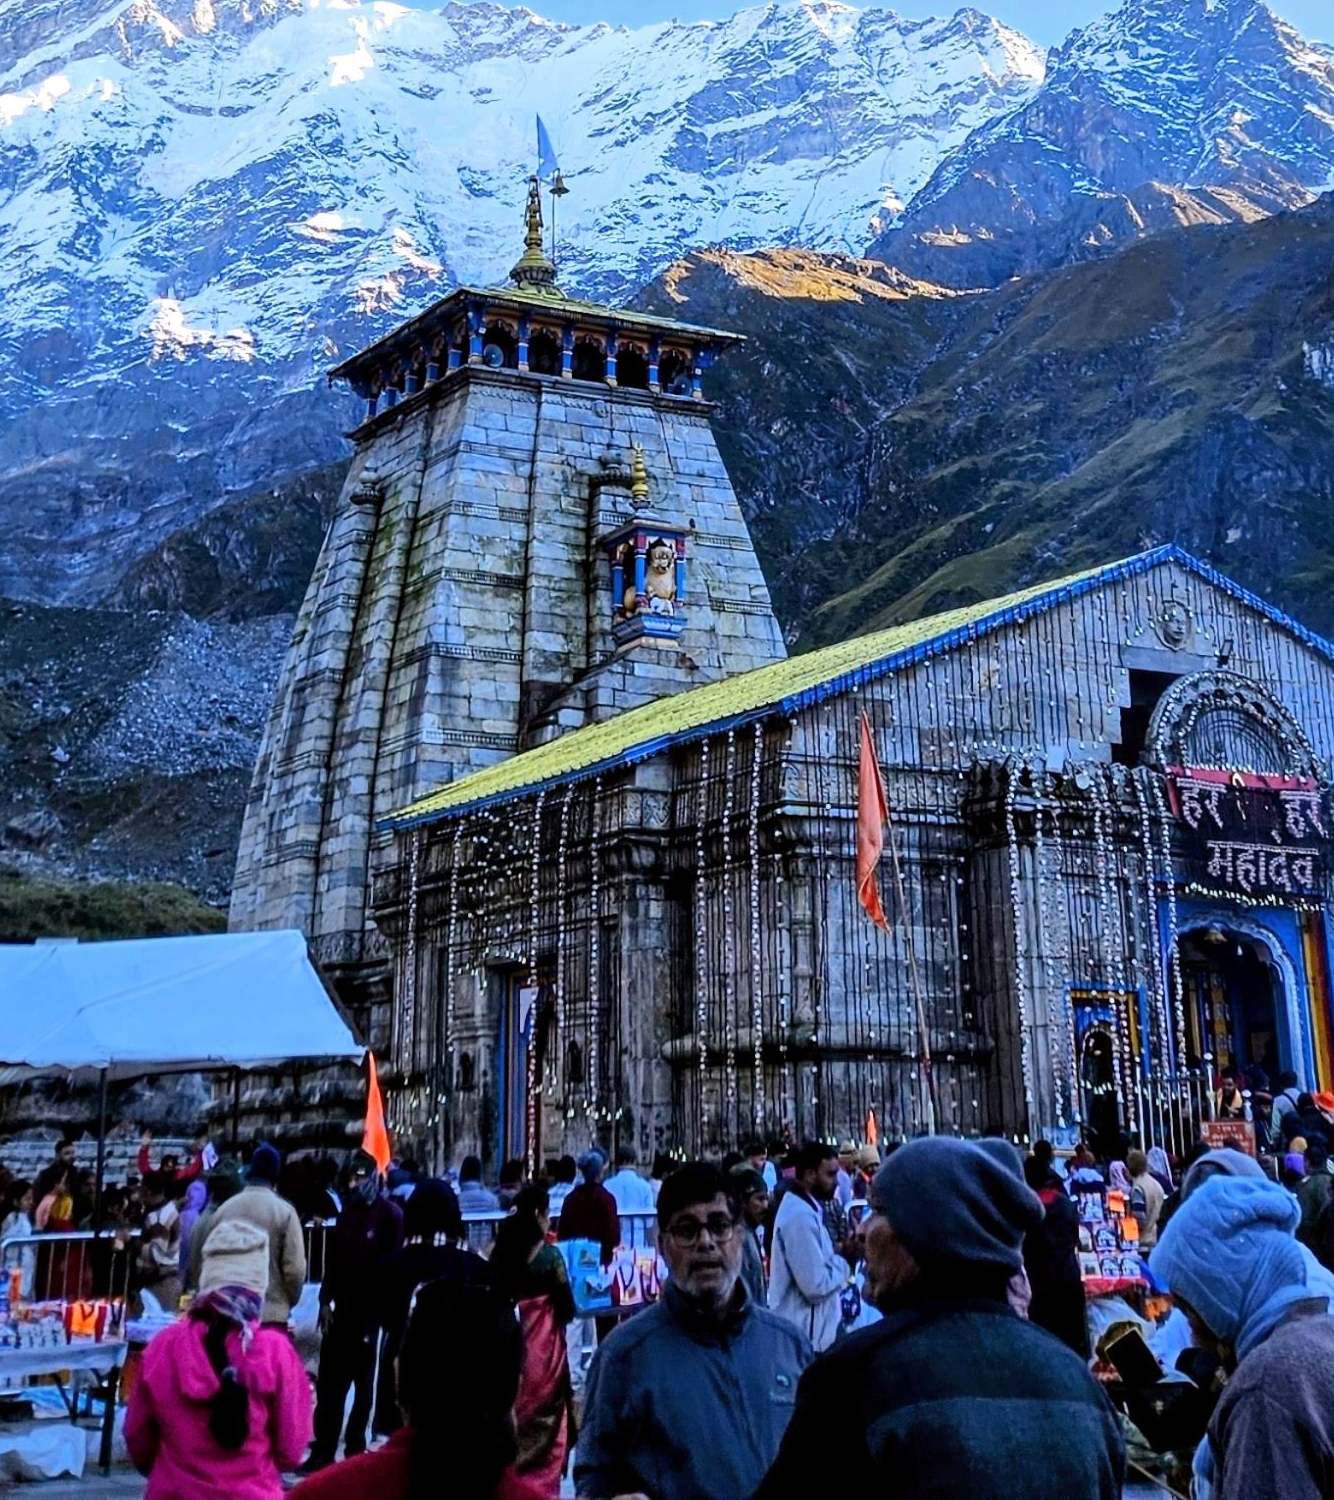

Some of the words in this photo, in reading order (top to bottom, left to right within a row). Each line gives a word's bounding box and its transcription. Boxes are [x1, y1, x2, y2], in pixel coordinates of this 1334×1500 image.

[1176, 777, 1227, 829] हर
[1280, 790, 1330, 839] हर
[1207, 831, 1319, 893] महादेव
